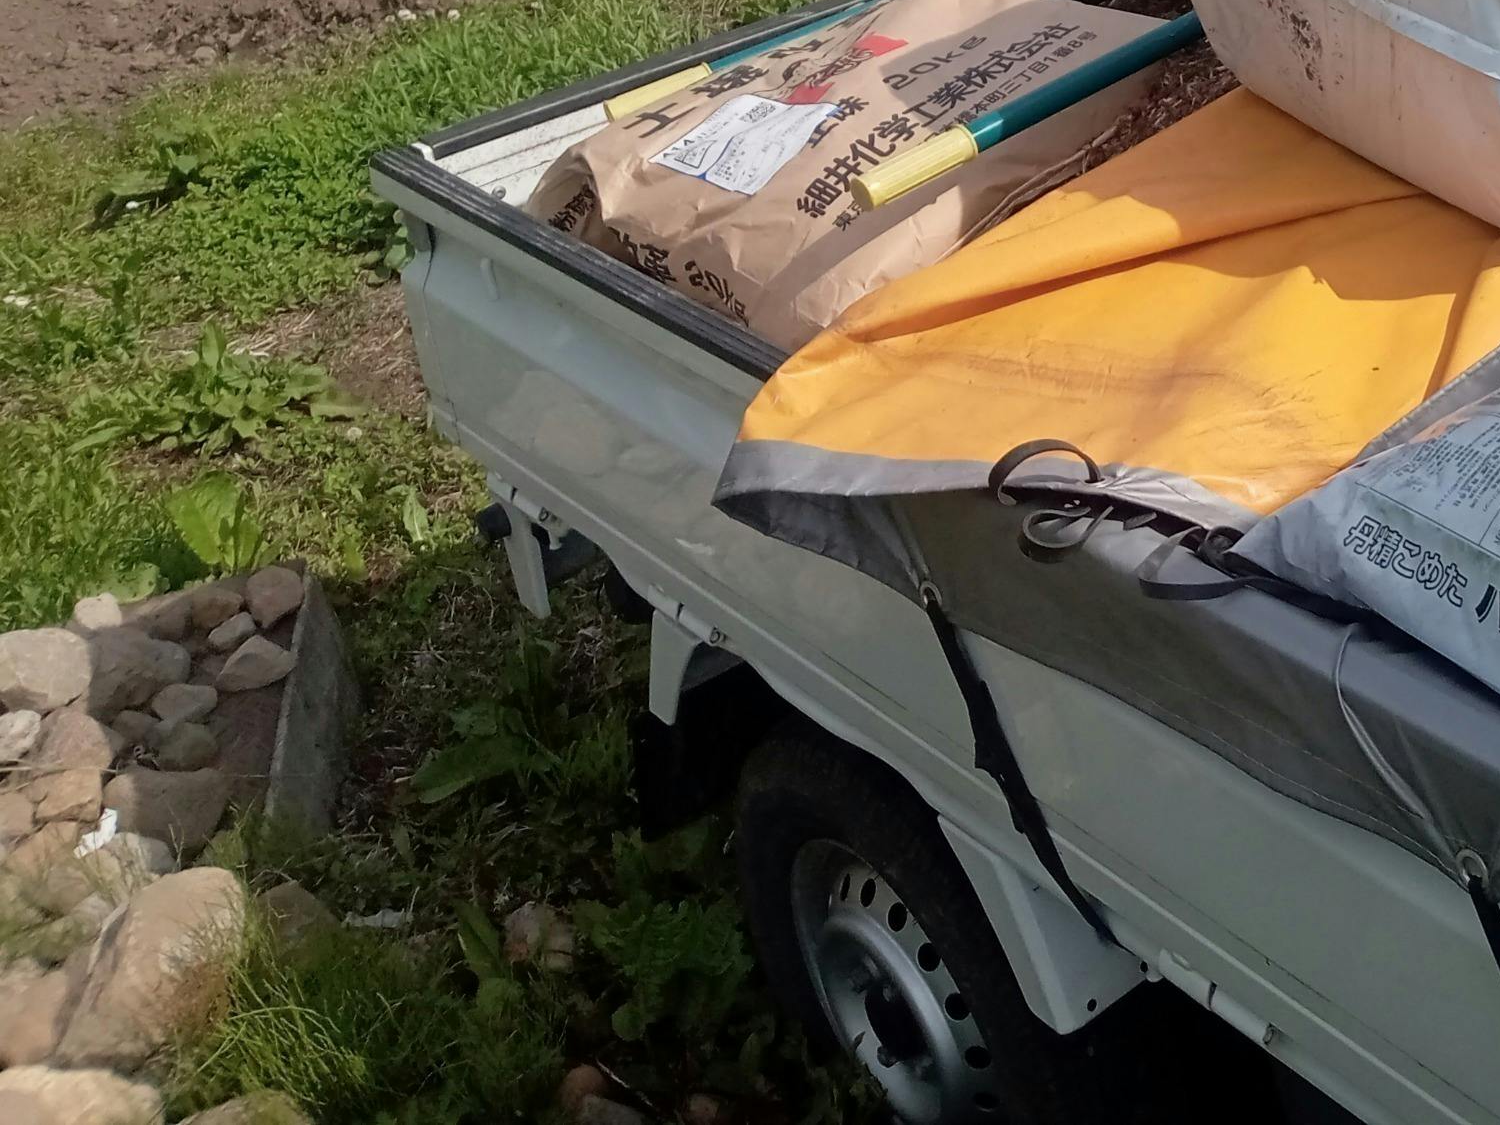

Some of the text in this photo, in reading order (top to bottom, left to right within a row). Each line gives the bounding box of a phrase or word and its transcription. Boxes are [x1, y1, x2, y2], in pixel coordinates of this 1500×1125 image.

[797, 22, 1081, 219] 細井化学工業株式会社
[1343, 515, 1469, 607] 丹精こめた
